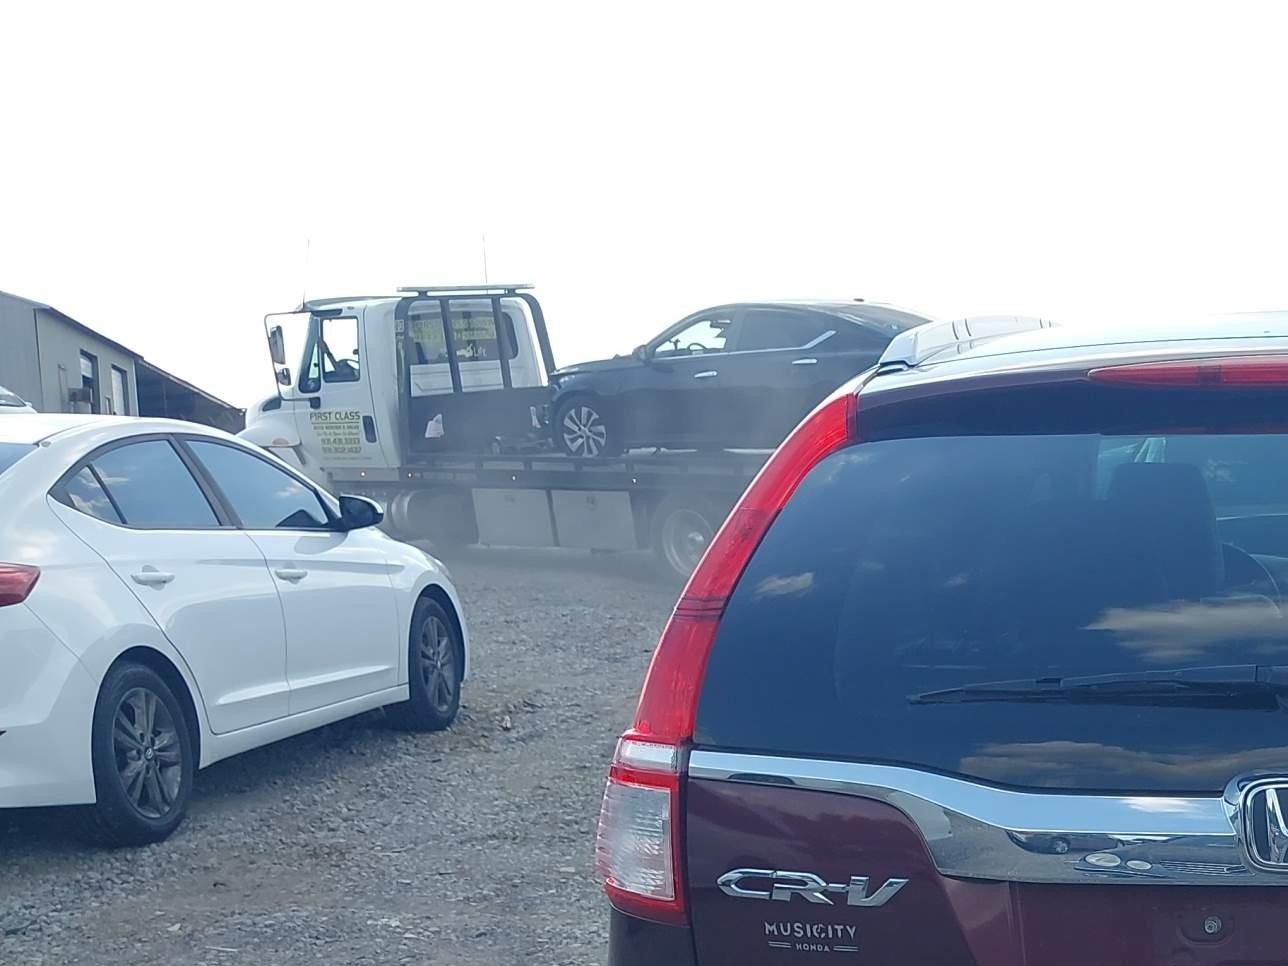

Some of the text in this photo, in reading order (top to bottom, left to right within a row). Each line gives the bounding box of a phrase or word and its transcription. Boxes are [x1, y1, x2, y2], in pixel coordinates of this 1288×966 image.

[310, 410, 360, 421] FIRST CLASS
[717, 868, 909, 907] CR-V
[765, 921, 856, 940] MUSICITY
[796, 942, 831, 953] HONDA
